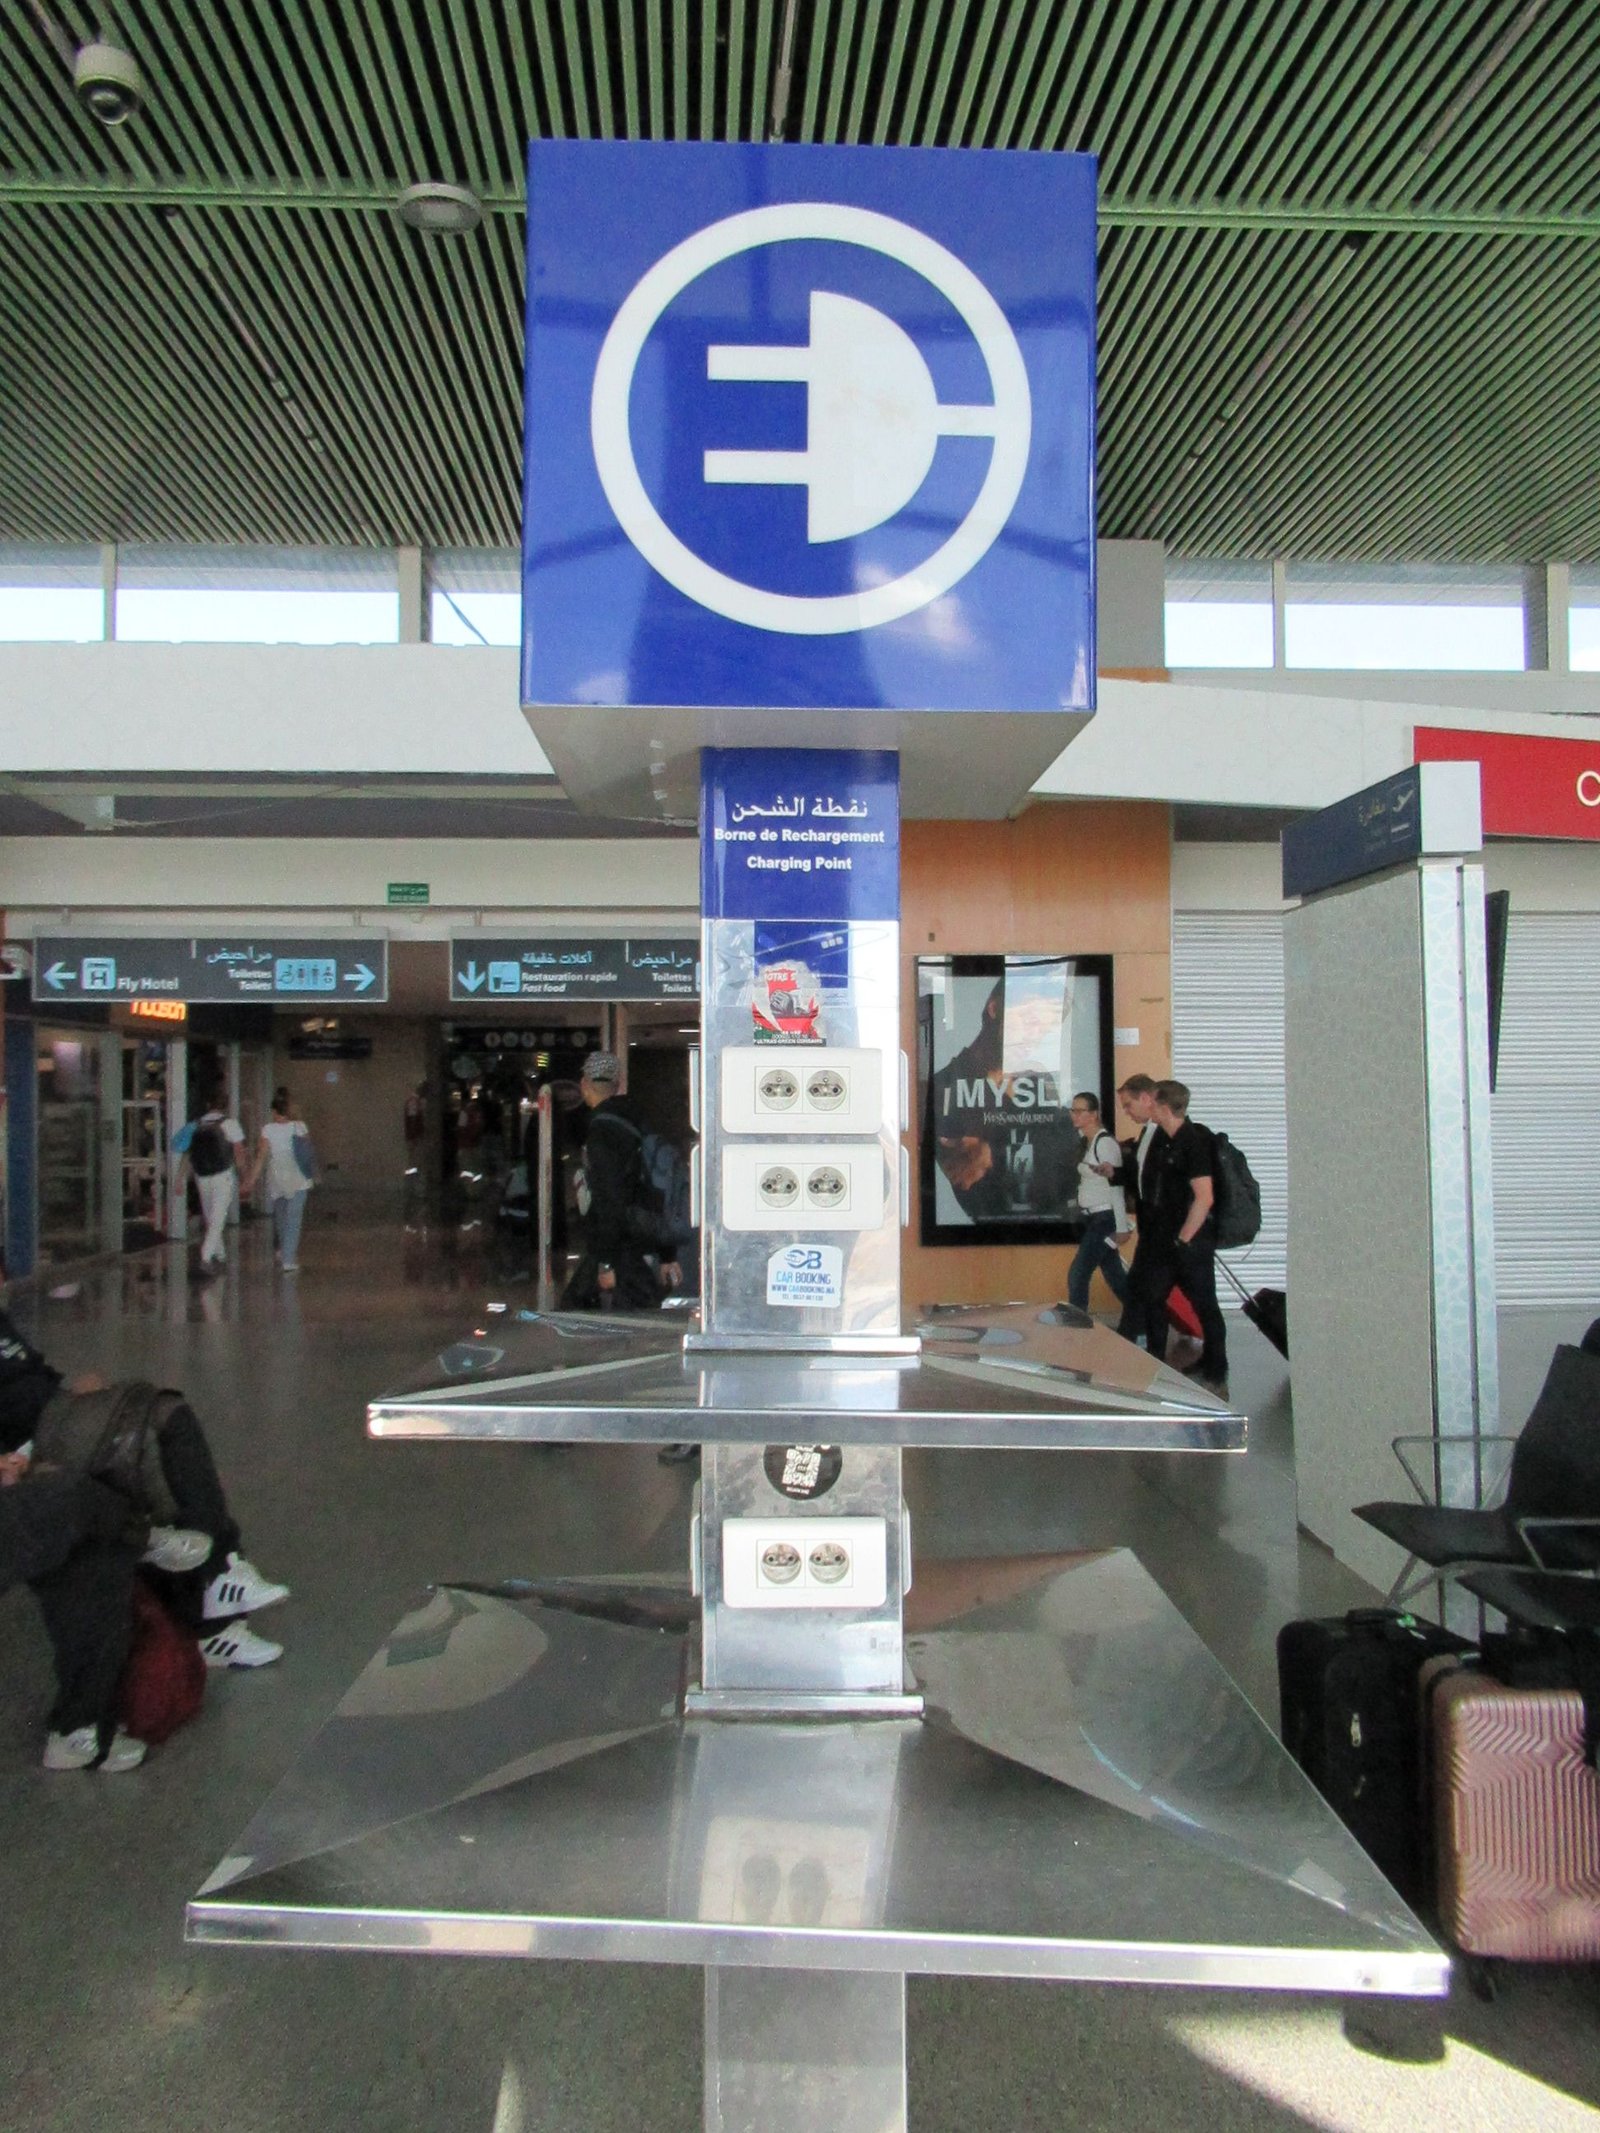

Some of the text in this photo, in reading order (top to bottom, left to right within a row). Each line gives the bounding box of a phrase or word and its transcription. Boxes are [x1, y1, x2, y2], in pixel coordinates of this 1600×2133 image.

[732, 796, 868, 822] نقطة الشحن
[714, 828, 885, 844] Borne de Rechargement
[747, 856, 852, 871] Charging Point
[207, 946, 272, 964] مراحيض
[558, 950, 593, 965] أكلات
[632, 951, 693, 968] مراحيض
[228, 968, 272, 979] Toilettes
[522, 971, 617, 983] Restauration rapide
[652, 972, 693, 982] Toilettes
[118, 977, 179, 992] Fly Hotel
[522, 983, 567, 993] Fast food
[663, 983, 693, 993] Toilets
[776, 1271, 831, 1284] CAR BOOKING
